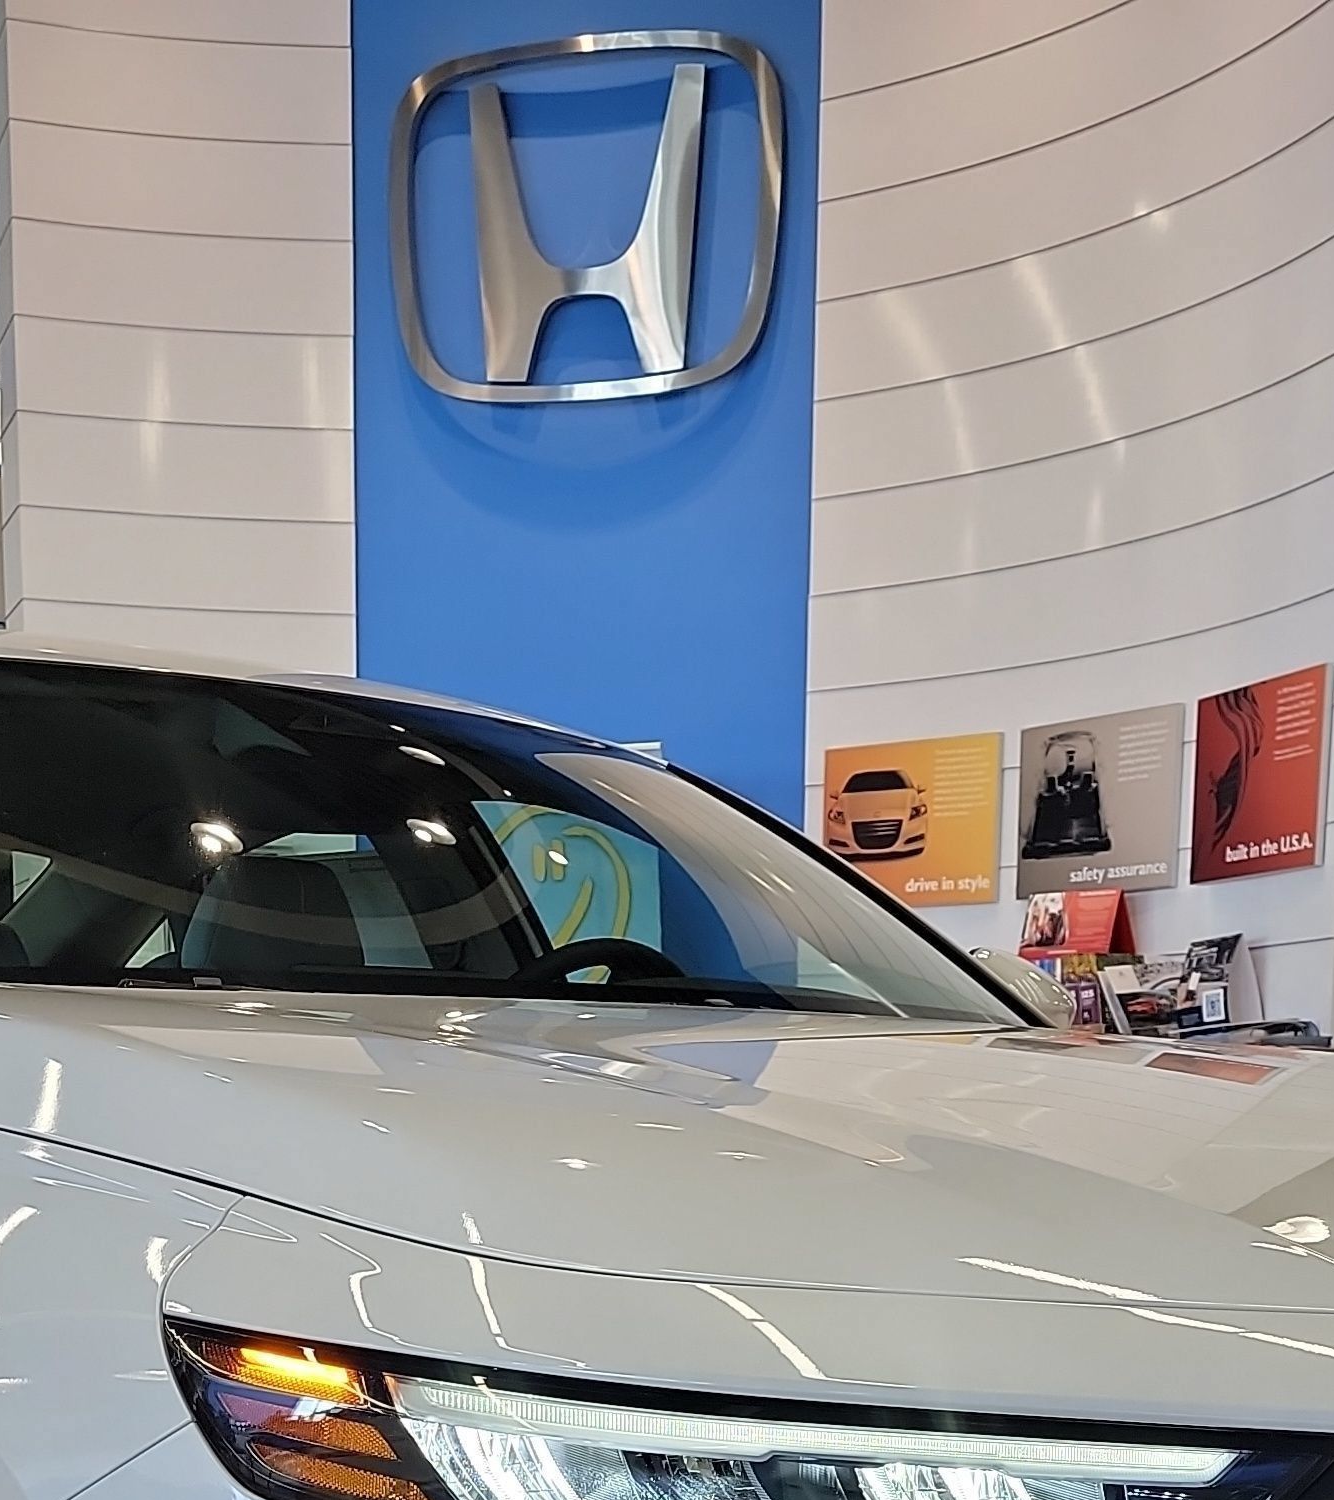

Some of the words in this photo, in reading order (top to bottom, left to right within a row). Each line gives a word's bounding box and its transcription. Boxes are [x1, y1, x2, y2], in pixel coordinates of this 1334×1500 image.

[1225, 843, 1249, 863] built
[1249, 841, 1260, 858] in
[1261, 838, 1279, 857] the
[1280, 831, 1314, 853] U.S.A.
[905, 877, 939, 893] drive
[941, 875, 955, 891] in
[958, 874, 991, 893] style
[1069, 866, 1105, 884] safety
[1107, 862, 1168, 879] assurance
